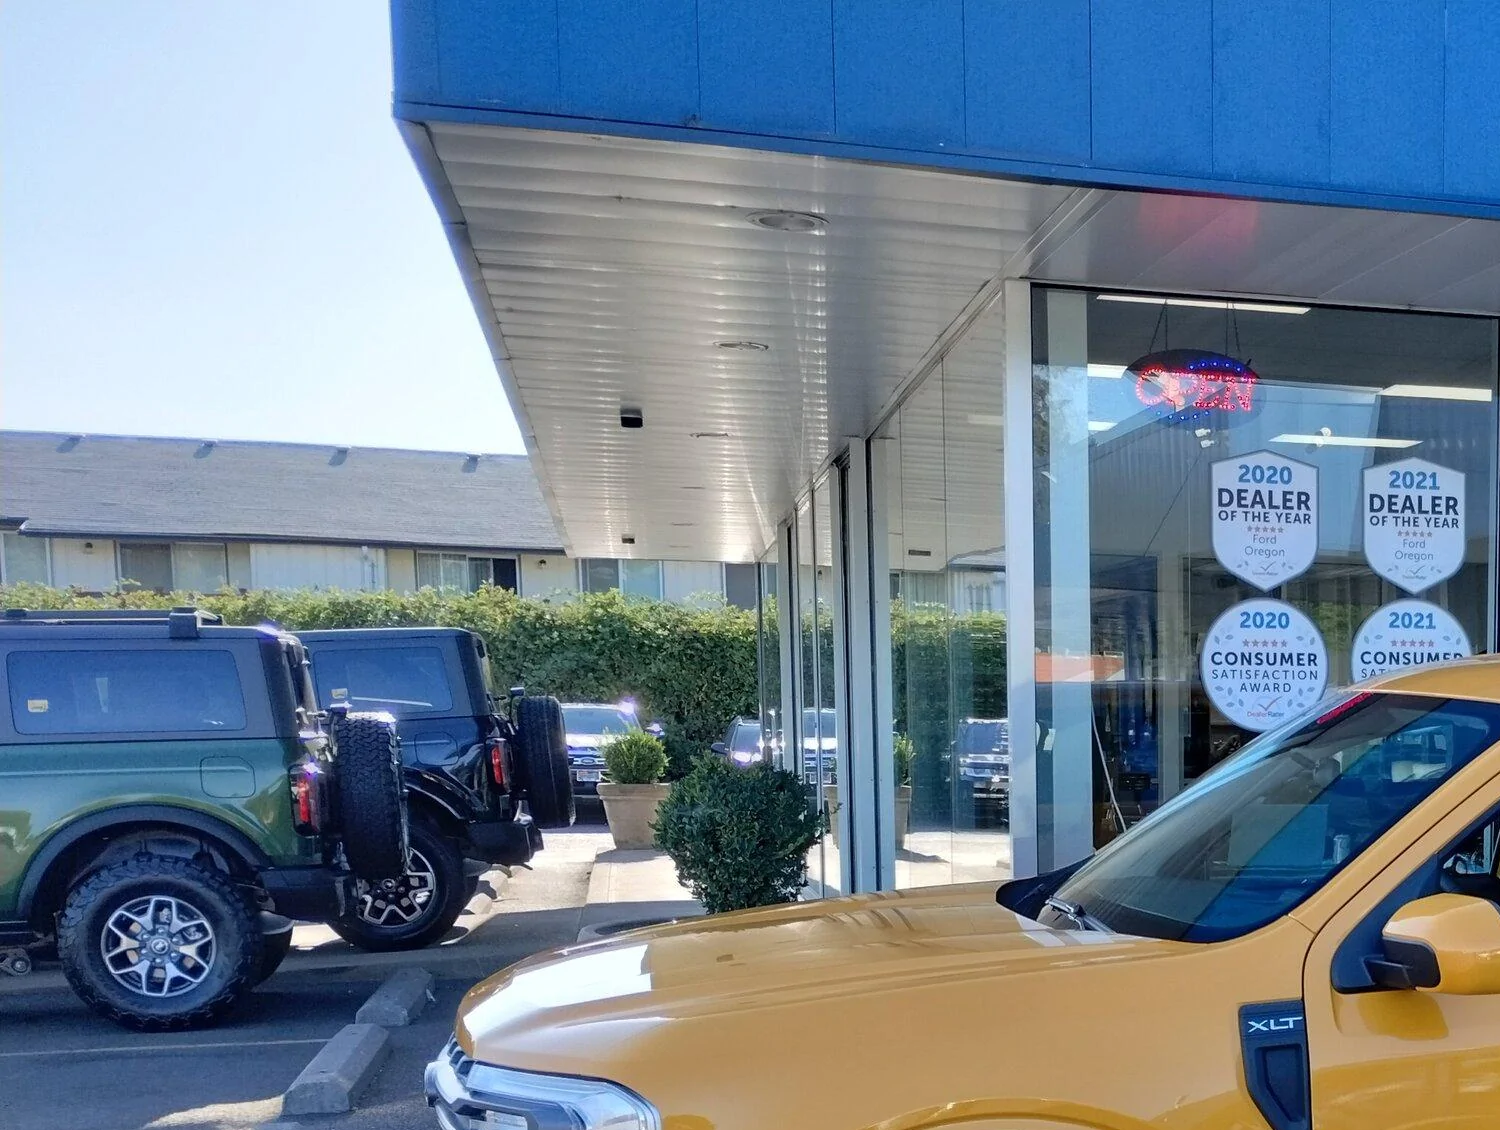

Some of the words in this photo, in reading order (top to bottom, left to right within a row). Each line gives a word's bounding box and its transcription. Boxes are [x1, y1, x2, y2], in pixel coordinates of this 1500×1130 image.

[1136, 369, 1256, 411] OPEN
[1238, 464, 1293, 484] 2020
[1388, 470, 1440, 490] 2021
[1217, 488, 1312, 511] DEALER
[1369, 494, 1459, 515] DEALER
[1218, 510, 1237, 522] OF
[1242, 511, 1273, 523] THE
[1276, 512, 1312, 525] YEAR
[1369, 515, 1388, 527] OF
[1392, 516, 1420, 528] THE
[1424, 517, 1459, 529] YEAR
[1252, 534, 1277, 545] Ford
[1402, 538, 1426, 549] Ford
[1244, 546, 1286, 559] Oregon
[1394, 550, 1434, 562] Oregon
[1239, 611, 1290, 630] 2020
[1388, 612, 1437, 630] 2021
[1210, 652, 1318, 667] CONSUMER
[1211, 669, 1318, 681] SATISFACTION
[1240, 682, 1292, 693] AWARD
[1248, 1017, 1303, 1033] XLT
